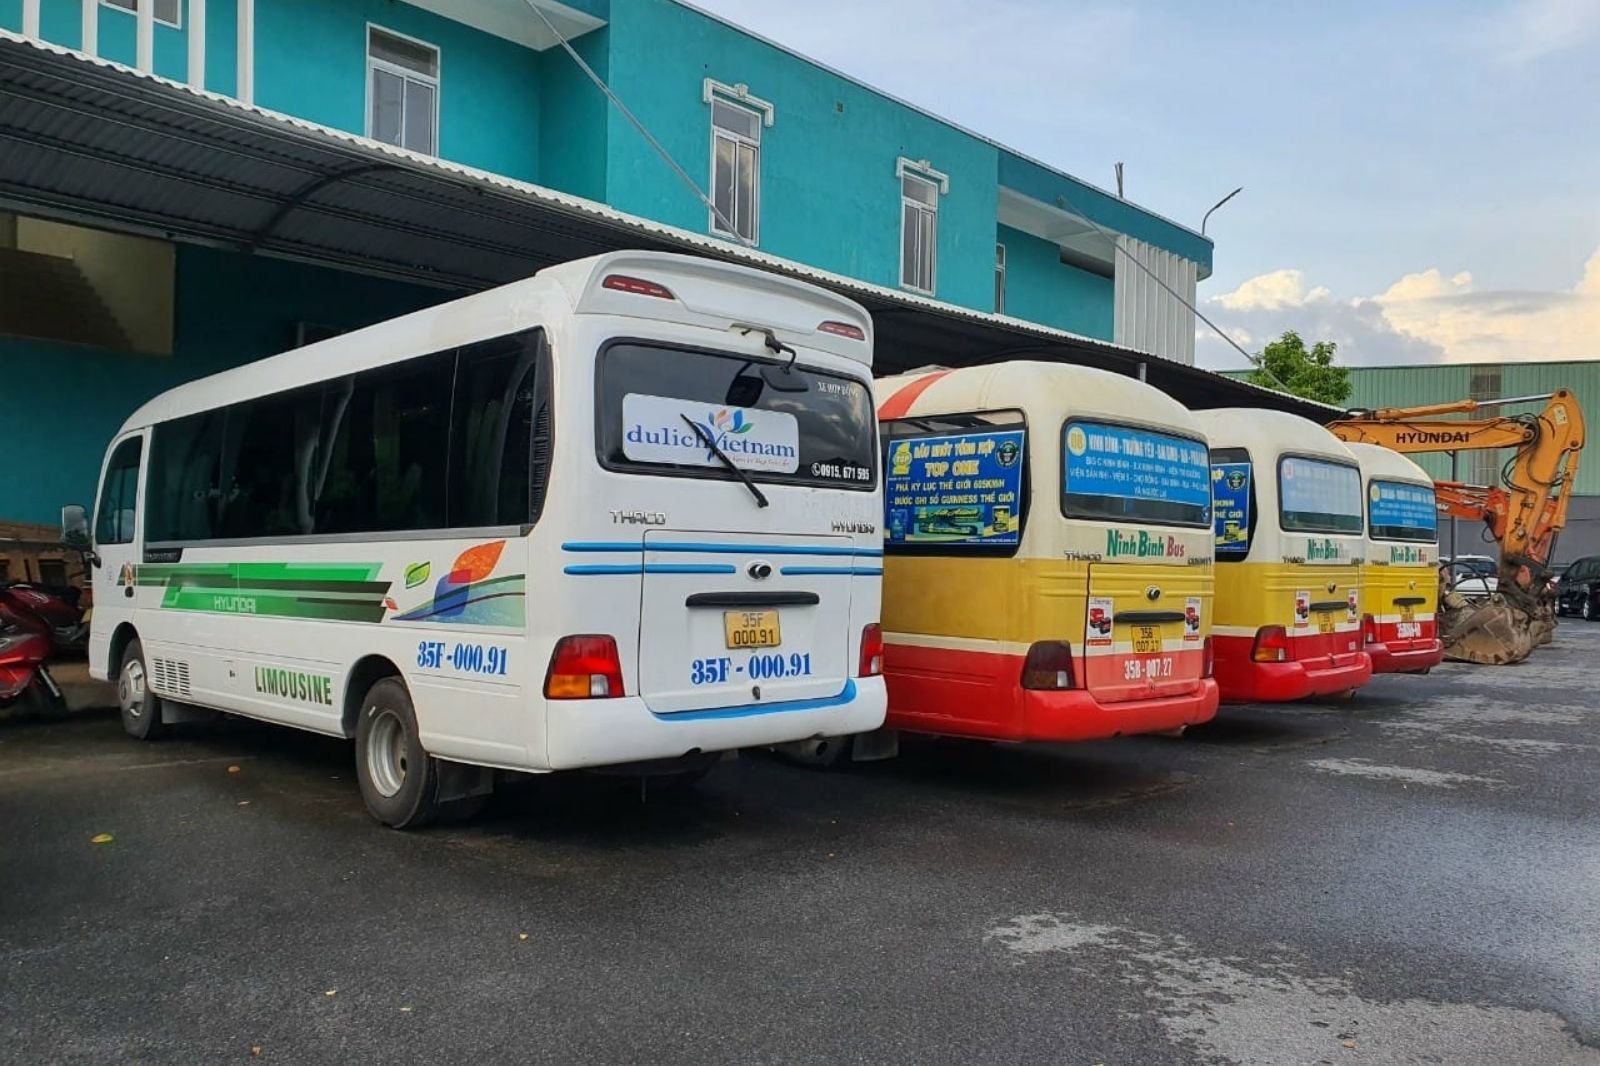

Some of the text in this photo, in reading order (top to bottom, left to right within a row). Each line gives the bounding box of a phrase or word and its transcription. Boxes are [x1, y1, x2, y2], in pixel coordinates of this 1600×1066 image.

[1396, 431, 1470, 444] HYUNDAI
[820, 464, 841, 478] 0915.
[843, 465, 856, 479] 671
[610, 510, 666, 524] THACO
[1166, 535, 1185, 557] Bus
[214, 597, 256, 614] HYUNDAI
[742, 612, 764, 628] 35F
[733, 630, 774, 645] 000.91
[255, 666, 333, 706] LIMOUSINE
